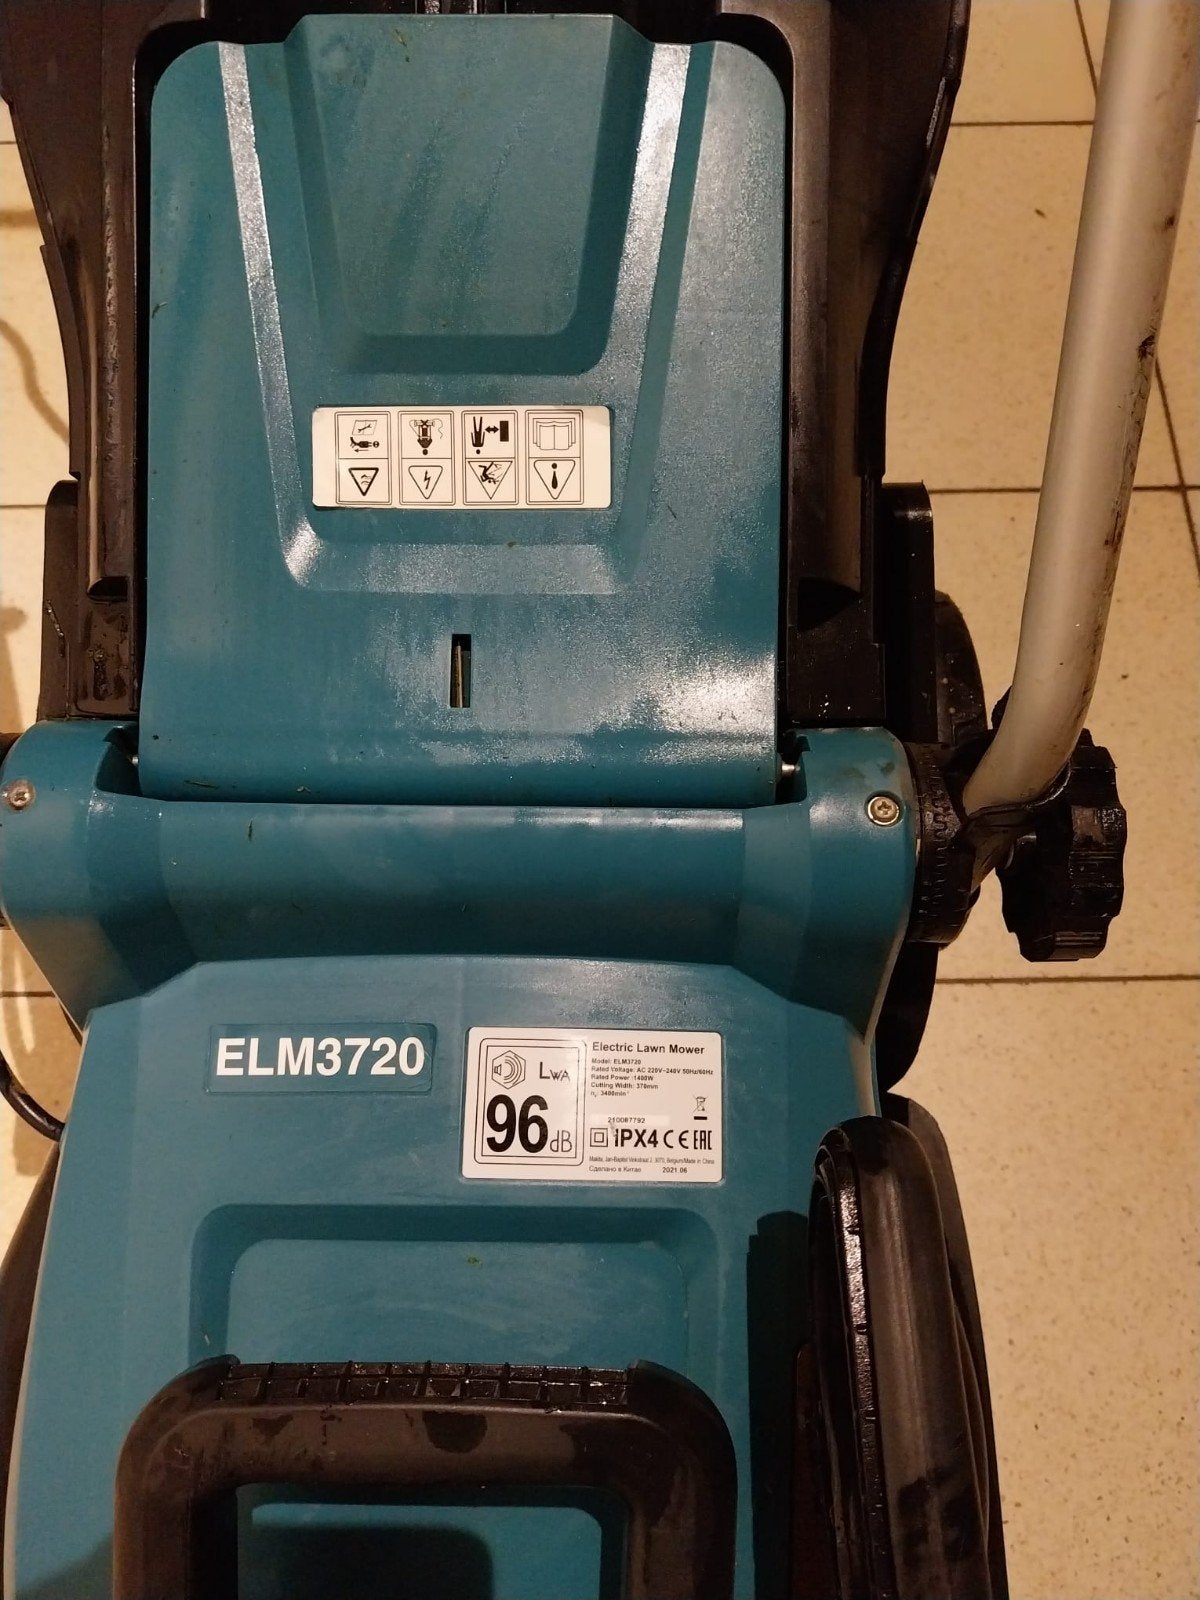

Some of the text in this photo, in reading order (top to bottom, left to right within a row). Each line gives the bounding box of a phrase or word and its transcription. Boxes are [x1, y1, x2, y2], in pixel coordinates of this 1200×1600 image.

[592, 1041, 705, 1054] Electric Lawn Mower
[216, 1036, 425, 1076] ELM3720
[487, 1094, 572, 1153] 96 dB
[607, 1116, 645, 1124] 210087792
[614, 1128, 658, 1148] IPX4
[589, 1165, 617, 1173] Сделано
